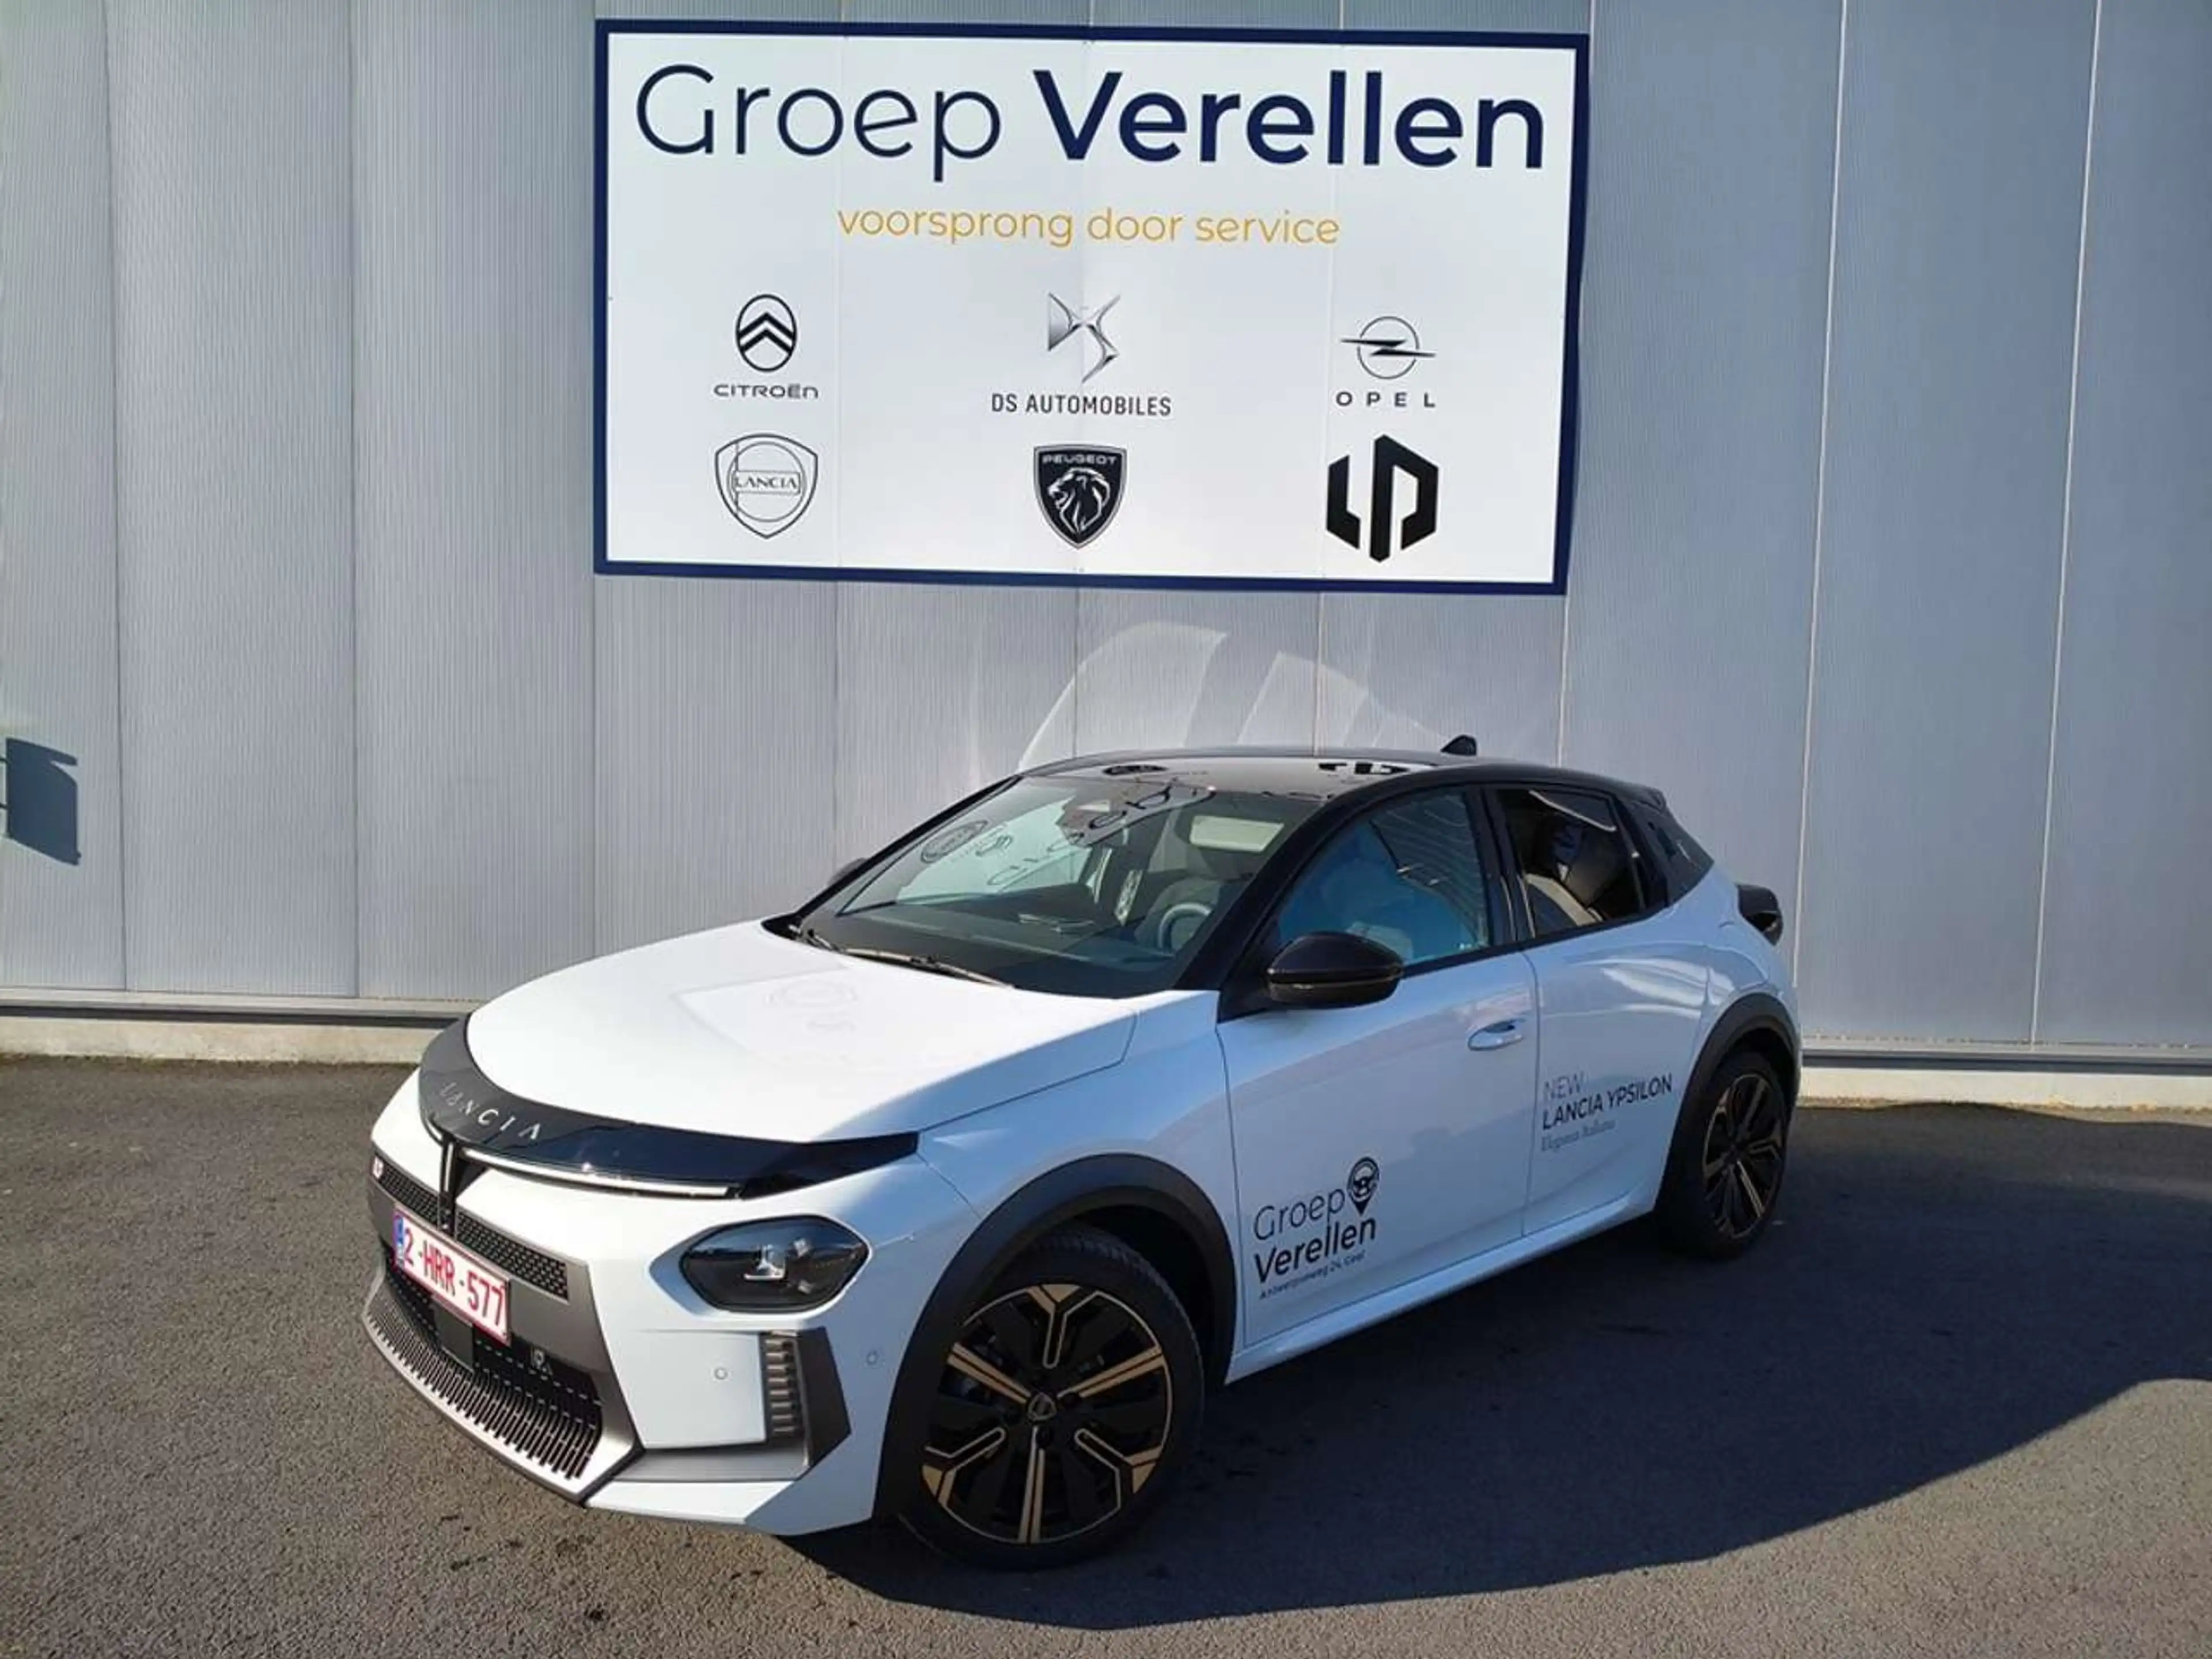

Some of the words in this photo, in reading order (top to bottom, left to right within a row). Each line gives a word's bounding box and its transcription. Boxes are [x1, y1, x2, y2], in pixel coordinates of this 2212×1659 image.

[636, 64, 1001, 182] Groep
[1033, 70, 1544, 168] Verellen
[838, 208, 1074, 248] voorsprong
[1087, 208, 1184, 242] door
[1195, 210, 1340, 244] service
[991, 393, 1017, 412] DS
[1026, 395, 1172, 416] AUTOMOBILES
[1336, 392, 1436, 408] OPEL
[1041, 453, 1116, 465] PEUGEOT
[734, 476, 798, 489] LANCIA
[1543, 1070, 1587, 1099] NEW
[1543, 1093, 1603, 1131] LANCIA
[1607, 1072, 1672, 1107] YPSILON
[440, 1082, 541, 1140] LANCIA
[1253, 1188, 1346, 1240] Groep
[1253, 1217, 1377, 1284] Verellen
